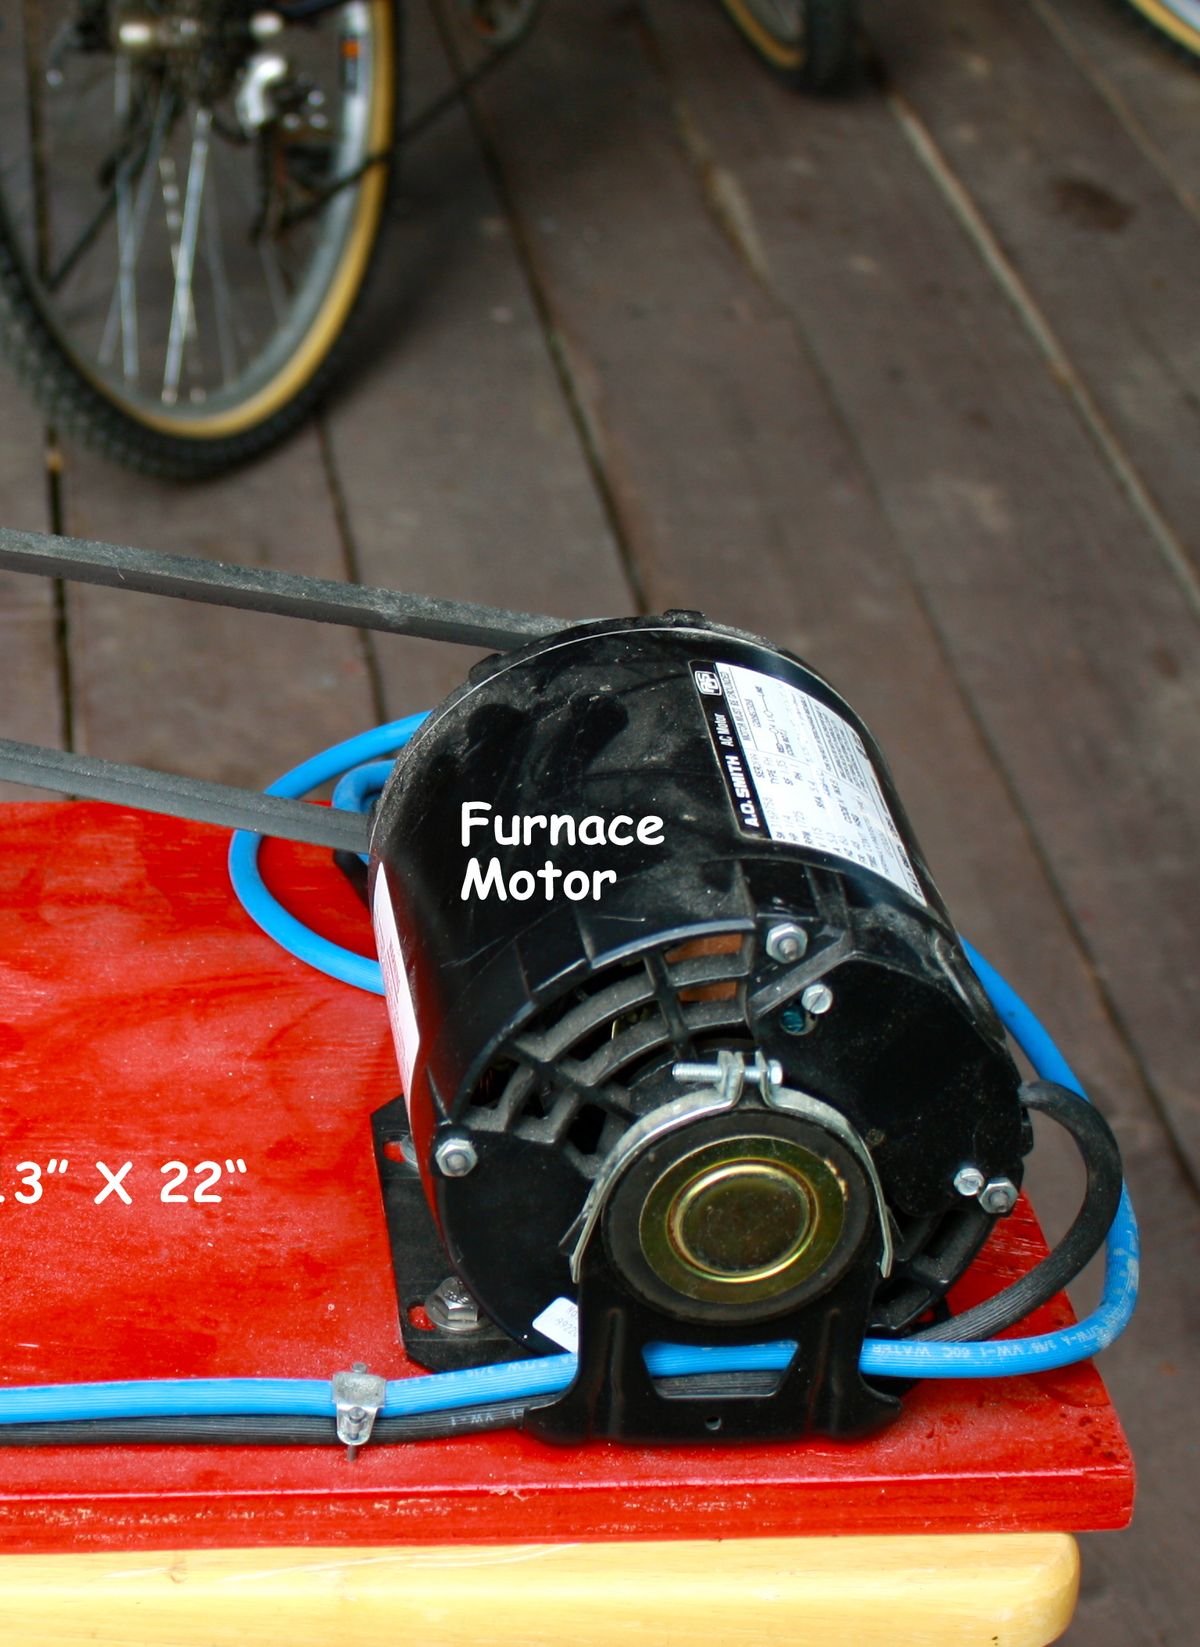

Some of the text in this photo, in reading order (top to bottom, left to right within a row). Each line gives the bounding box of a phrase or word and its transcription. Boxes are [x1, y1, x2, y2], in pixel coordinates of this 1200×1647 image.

[715, 714, 758, 826] A.O. SMITH AC Motor
